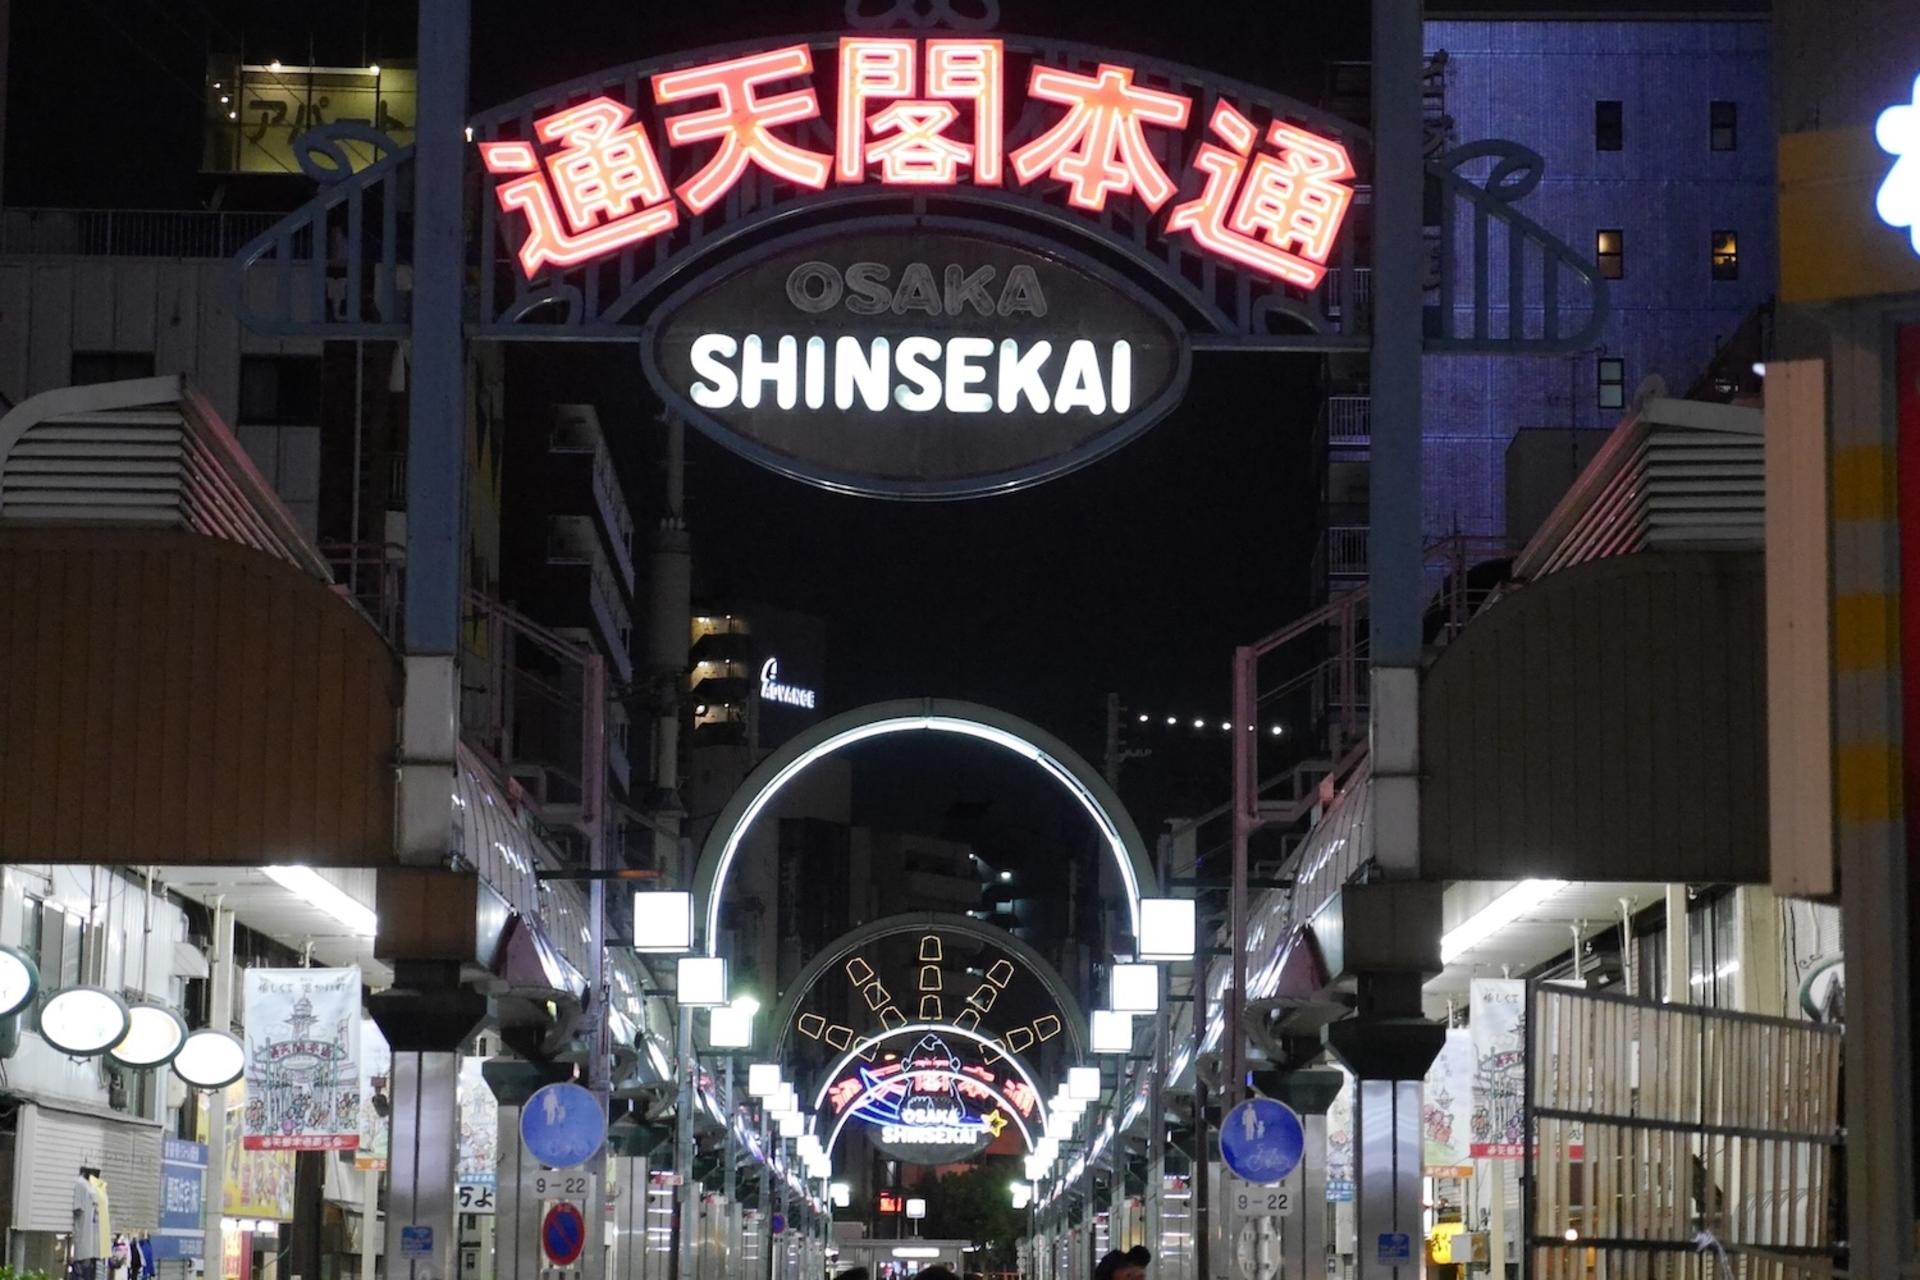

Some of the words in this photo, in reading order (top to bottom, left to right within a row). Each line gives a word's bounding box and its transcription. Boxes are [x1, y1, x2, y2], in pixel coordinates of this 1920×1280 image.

[478, 37, 1357, 290] 通天閣本通
[786, 260, 1048, 318] OSAKA
[689, 333, 1132, 416] SHINSEKAI
[881, 1125, 978, 1144] SHINSEKAI
[902, 1106, 960, 1125] OSAKA
